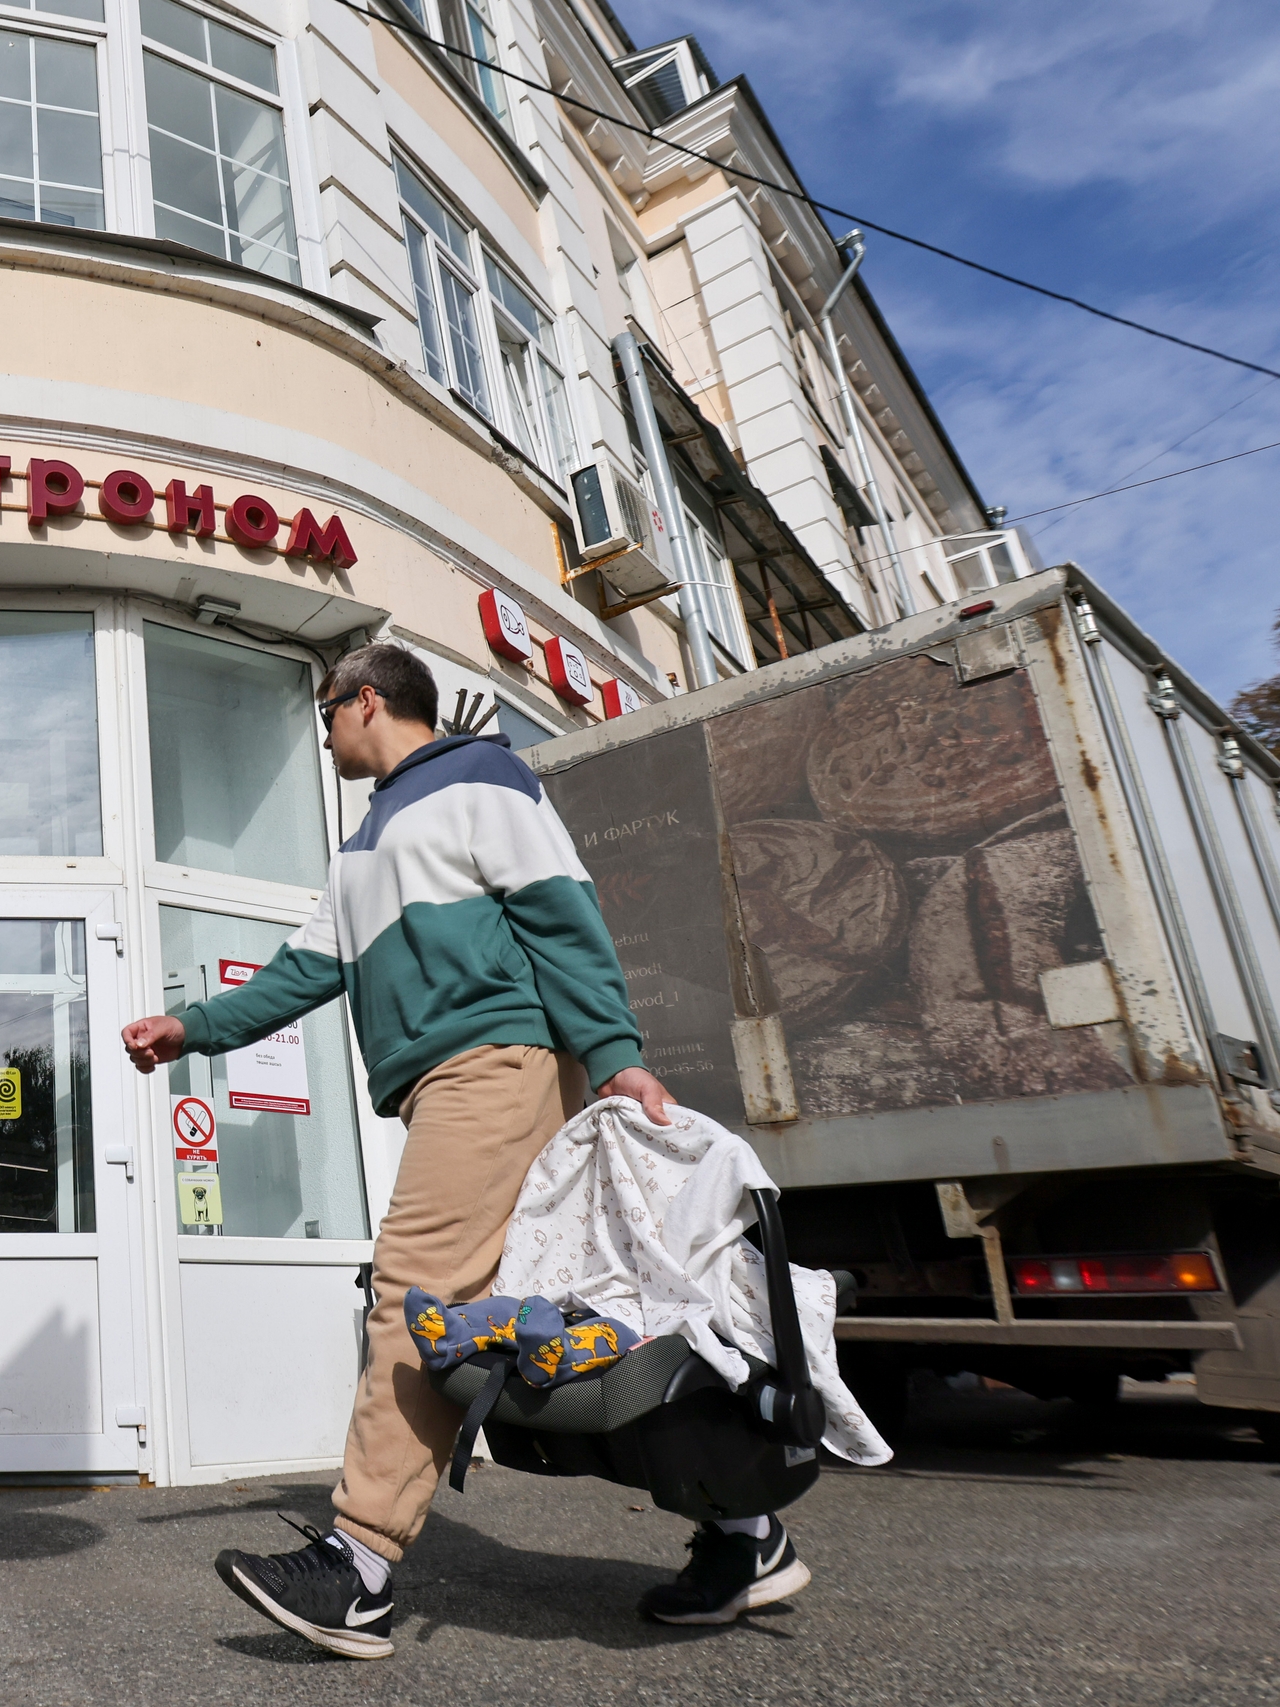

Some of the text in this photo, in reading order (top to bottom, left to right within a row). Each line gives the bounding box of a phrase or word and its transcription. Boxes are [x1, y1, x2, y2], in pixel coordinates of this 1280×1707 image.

[584, 809, 680, 848] И ФАРТУК
[627, 990, 679, 1010] avod_1
